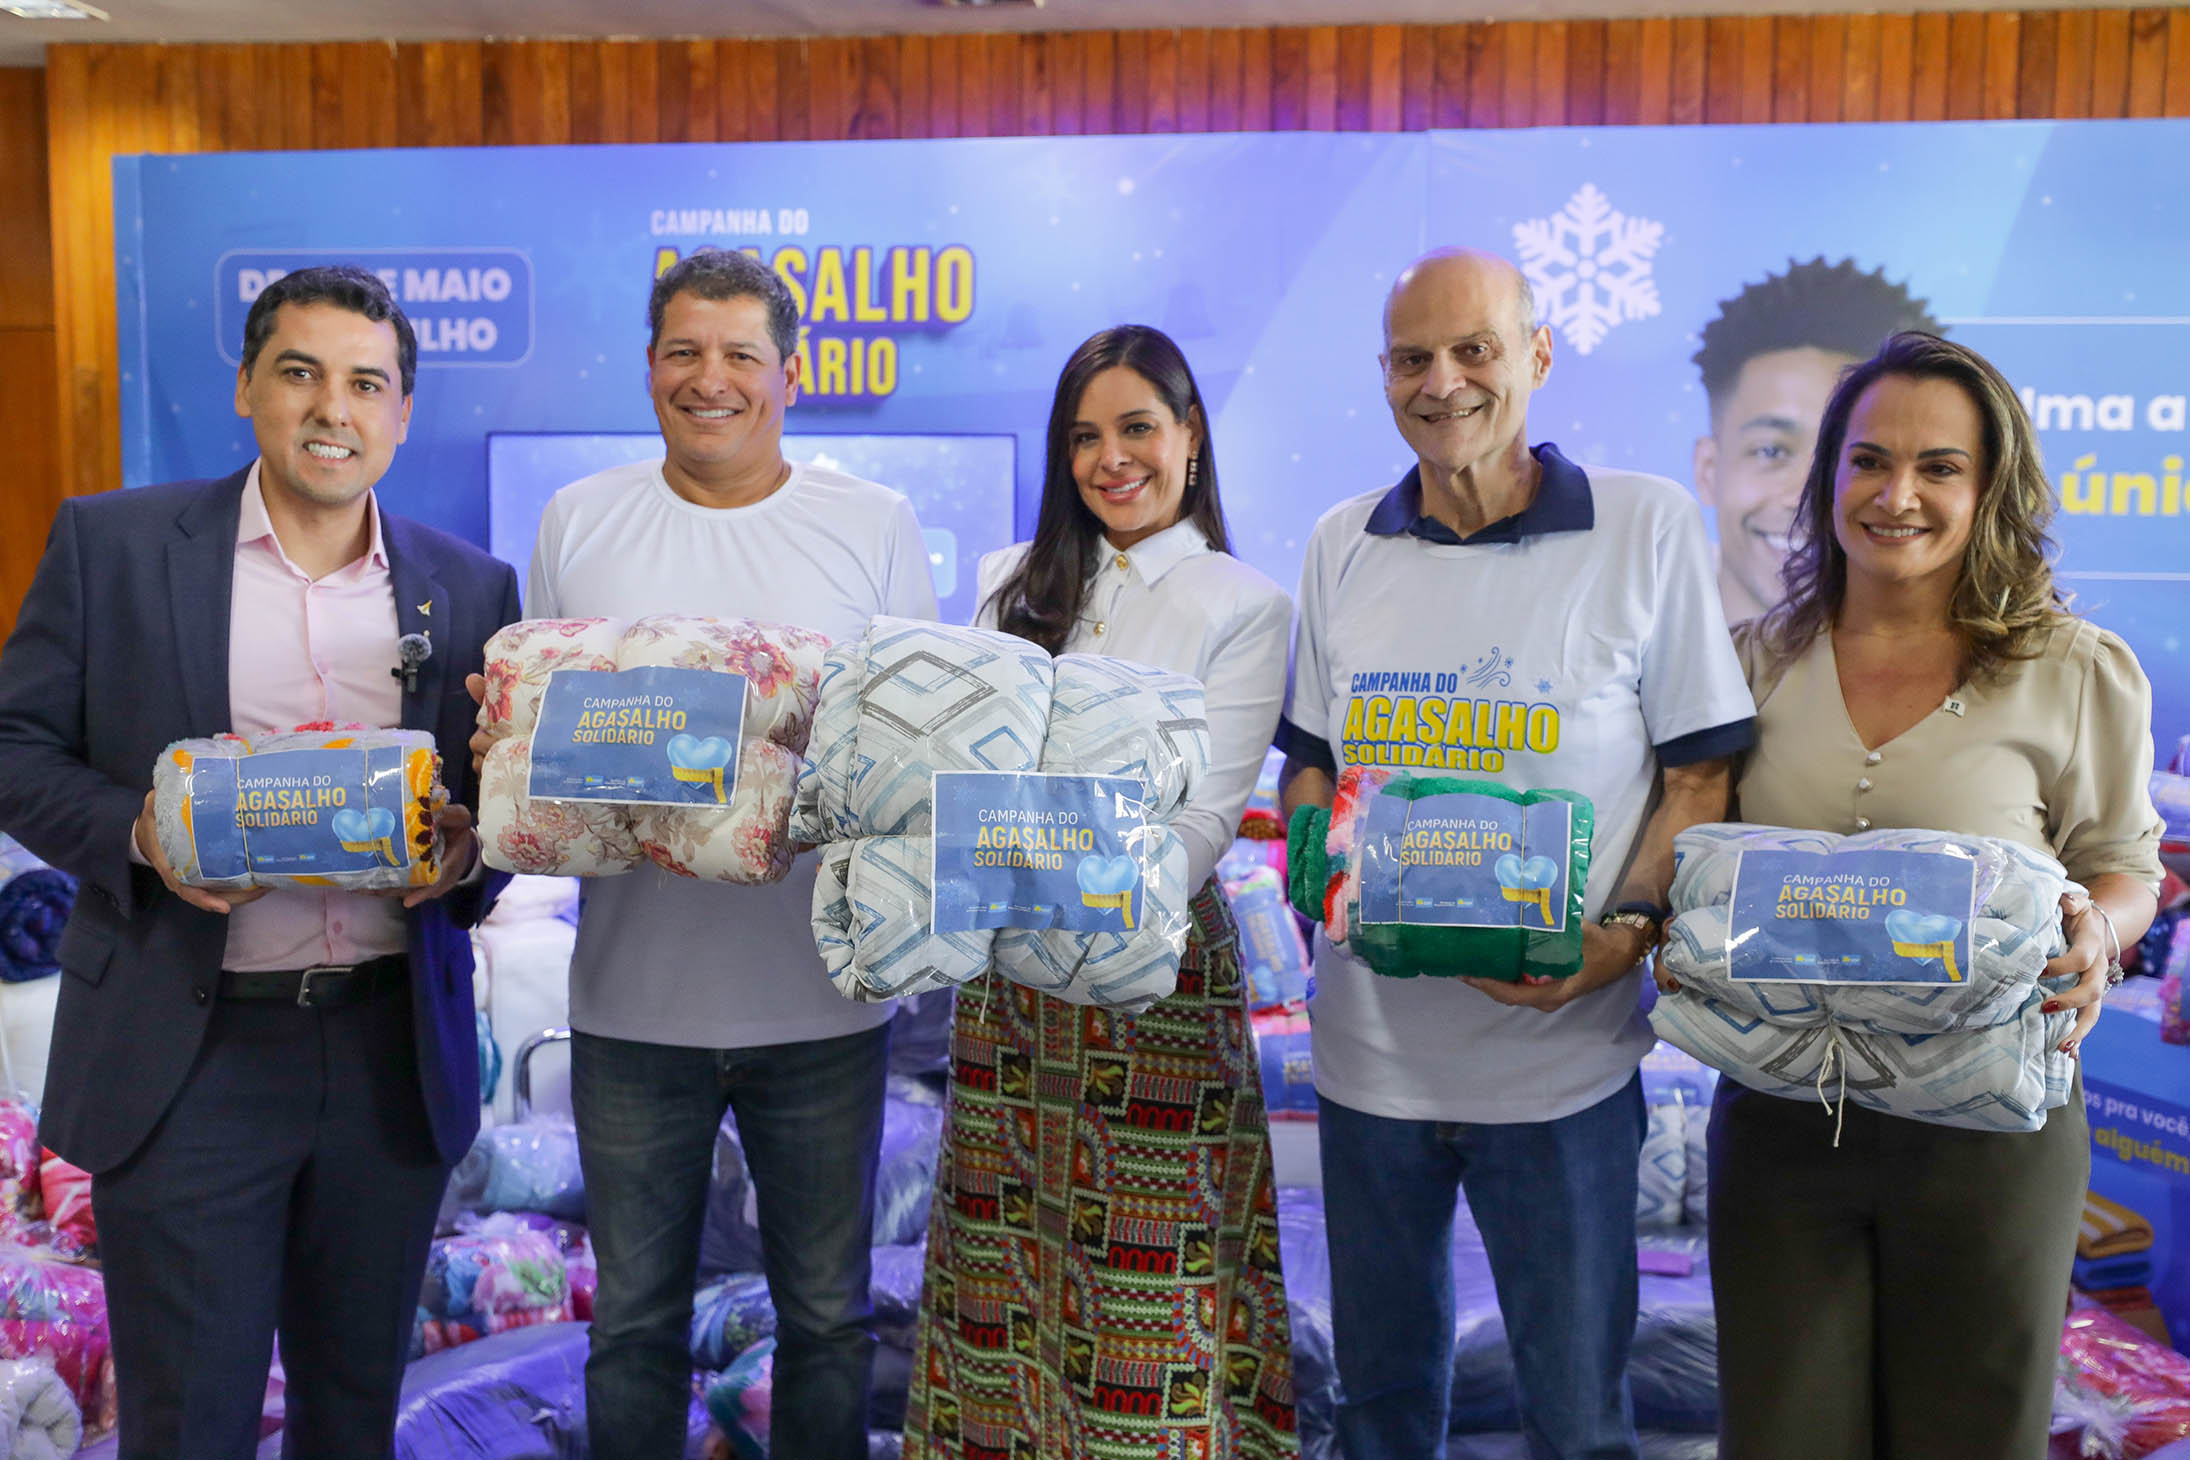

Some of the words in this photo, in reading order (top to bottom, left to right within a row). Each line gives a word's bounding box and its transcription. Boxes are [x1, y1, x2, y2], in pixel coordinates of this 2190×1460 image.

[651, 209, 772, 236] CAMPANHA
[778, 208, 809, 235] DO
[404, 267, 512, 302] MAIO
[2061, 453, 2190, 516] úni
[1351, 672, 1430, 693] CAMPANHA
[1435, 673, 1458, 693] DO
[584, 695, 651, 709] CAMPANHA
[655, 696, 673, 708] DO
[577, 708, 687, 731] AGASALHO
[1343, 695, 1560, 754] AGASALHO
[238, 777, 310, 789] CAMPANHA
[313, 775, 332, 786] DO
[235, 787, 347, 811] AGASALHO
[978, 809, 1054, 824] CAMPANHA
[1058, 811, 1078, 825] DO
[1407, 818, 1476, 831] CAMPANHA
[1480, 820, 1498, 830] DO
[976, 825, 1094, 851] AGASALHO
[1403, 830, 1512, 851] AGASALHO
[1783, 874, 1864, 886] CAMPANHA
[1869, 876, 1890, 887] DO
[1778, 884, 1907, 906] AGASALHO
[2104, 1096, 2138, 1120] pra
